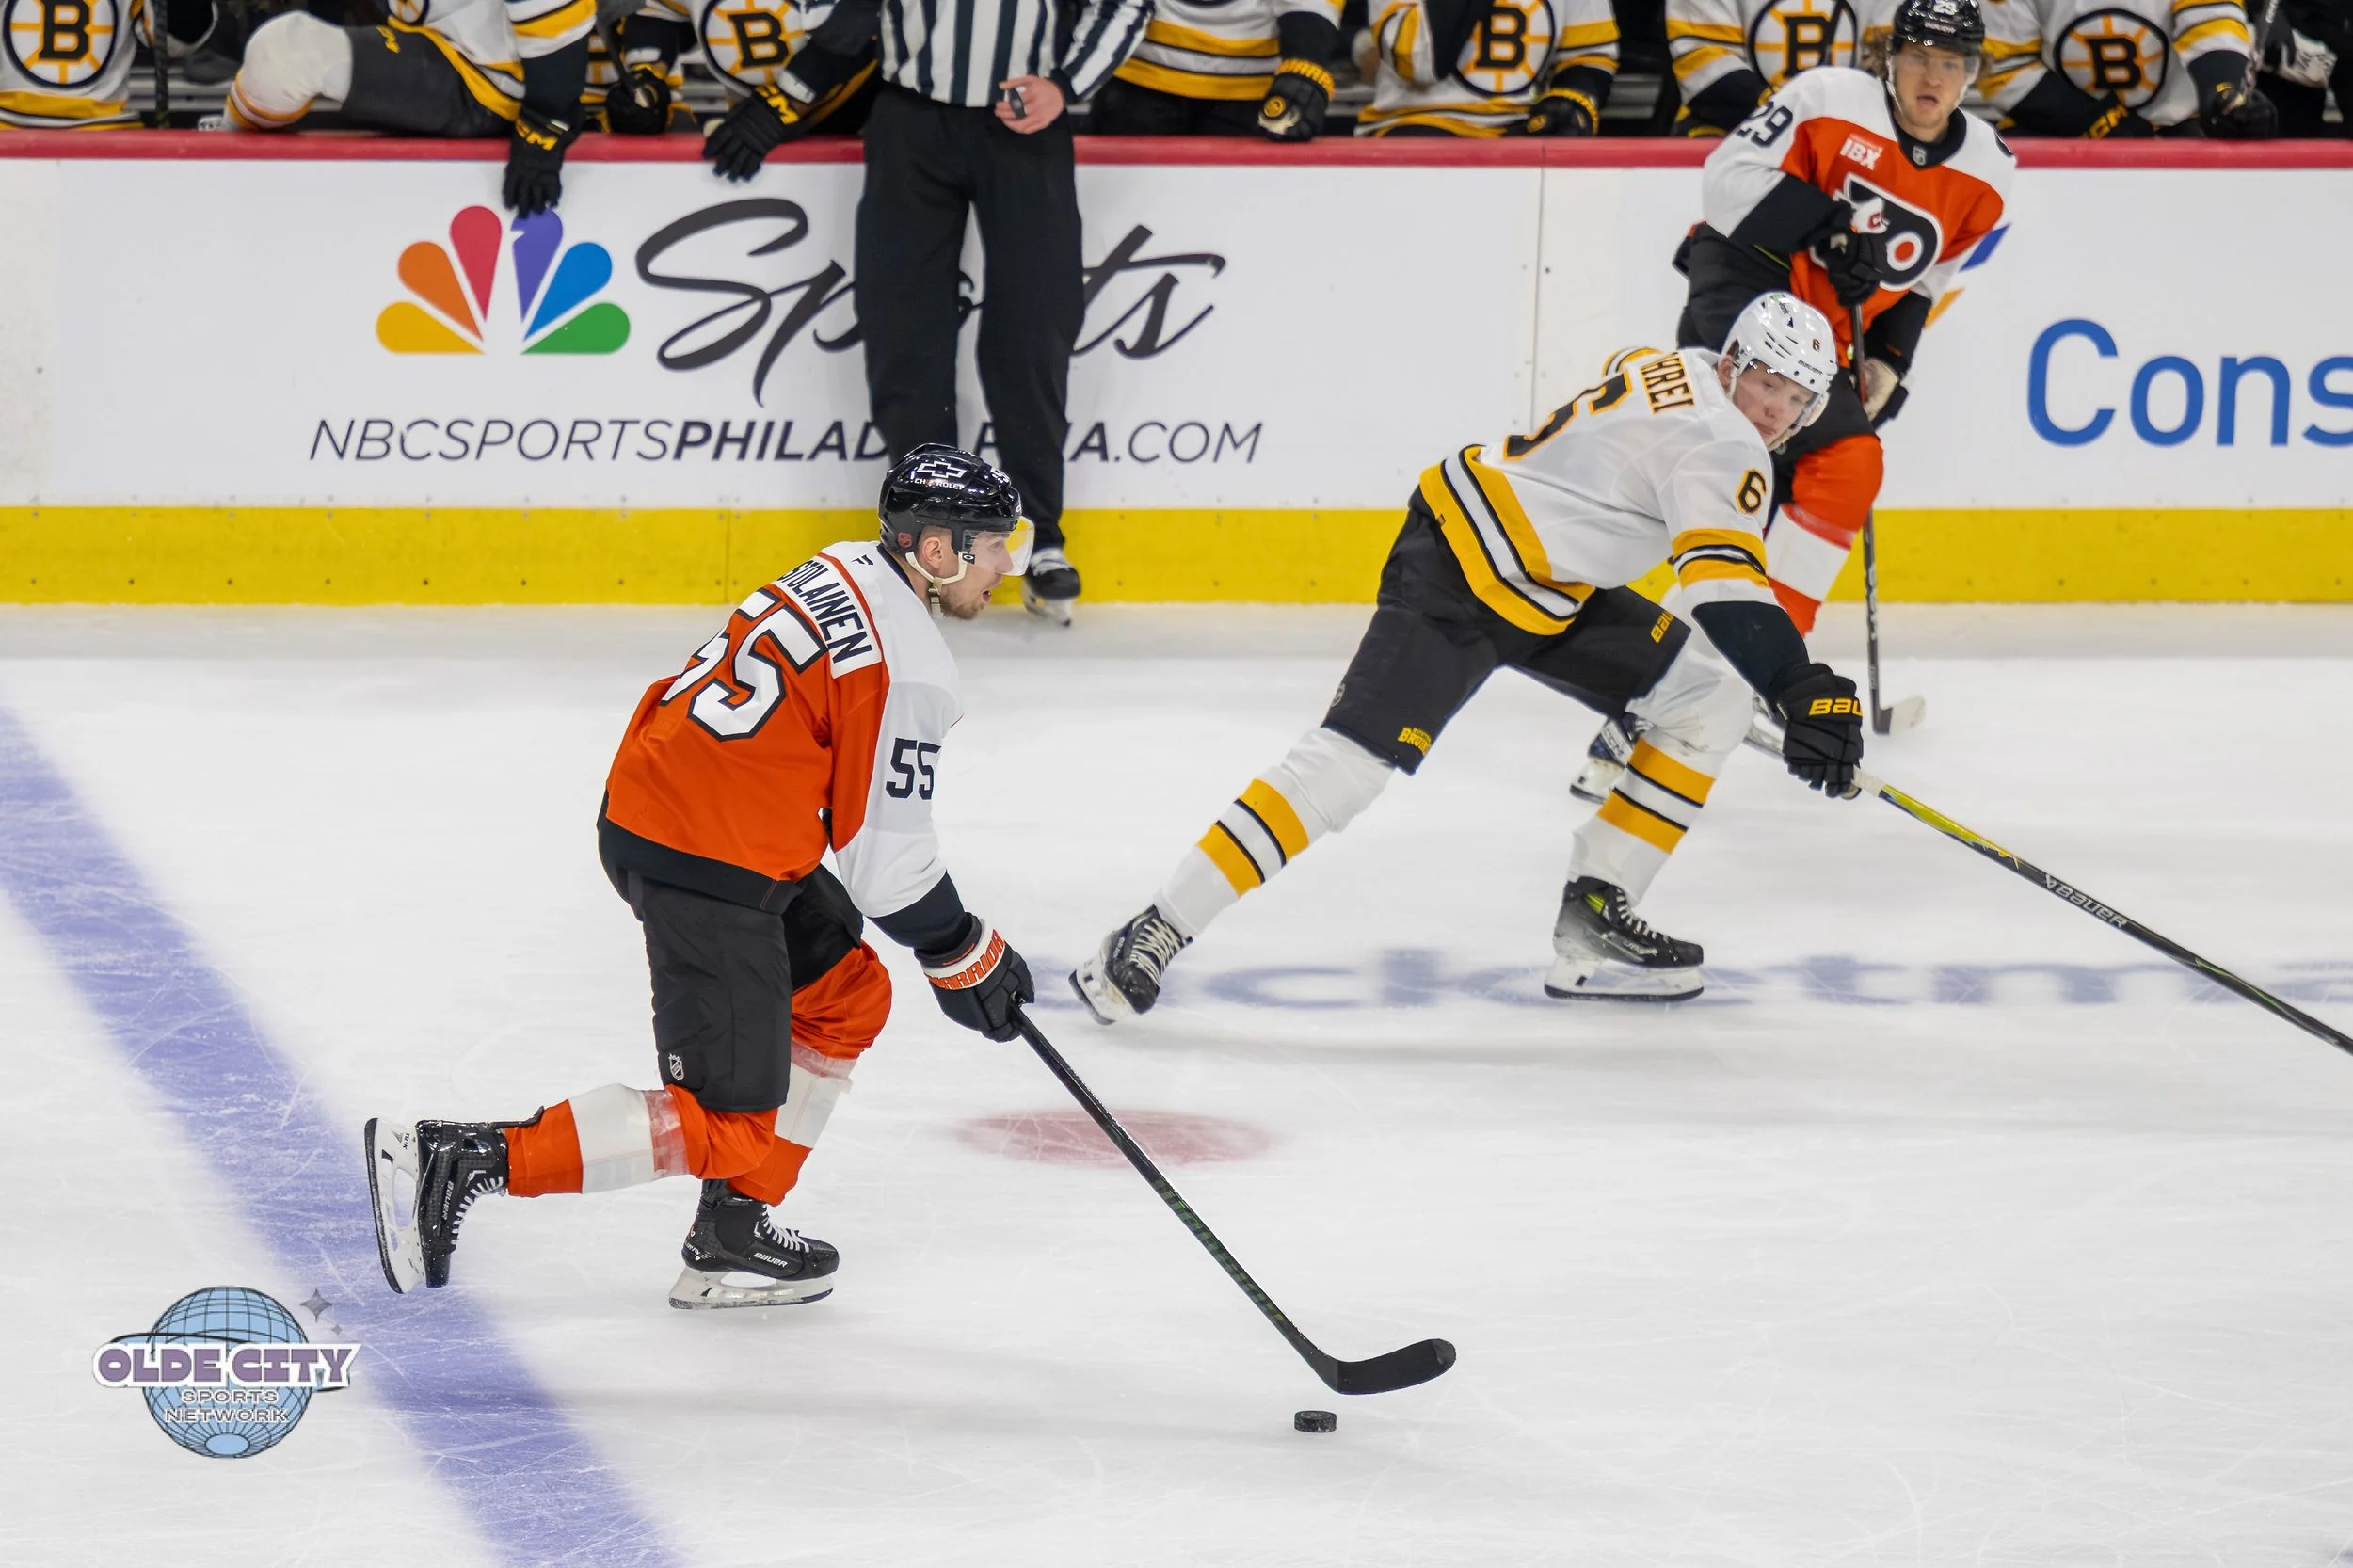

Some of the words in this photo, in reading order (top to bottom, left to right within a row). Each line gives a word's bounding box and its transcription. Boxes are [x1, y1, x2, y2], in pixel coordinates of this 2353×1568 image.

[39, 0, 92, 62] B
[728, 11, 791, 69] B
[1476, 6, 1528, 69] B
[1785, 15, 1828, 78] B
[2084, 36, 2142, 90] B
[1839, 138, 1881, 170] IBX
[634, 198, 1226, 408] Spts
[1641, 352, 1695, 414] HREI
[2026, 317, 2353, 448] Cons
[1736, 468, 1767, 515] 6
[1809, 696, 1864, 717] BAU
[885, 737, 941, 800] 55
[2054, 884, 2128, 928] BAUER
[753, 1252, 789, 1269] BAUER
